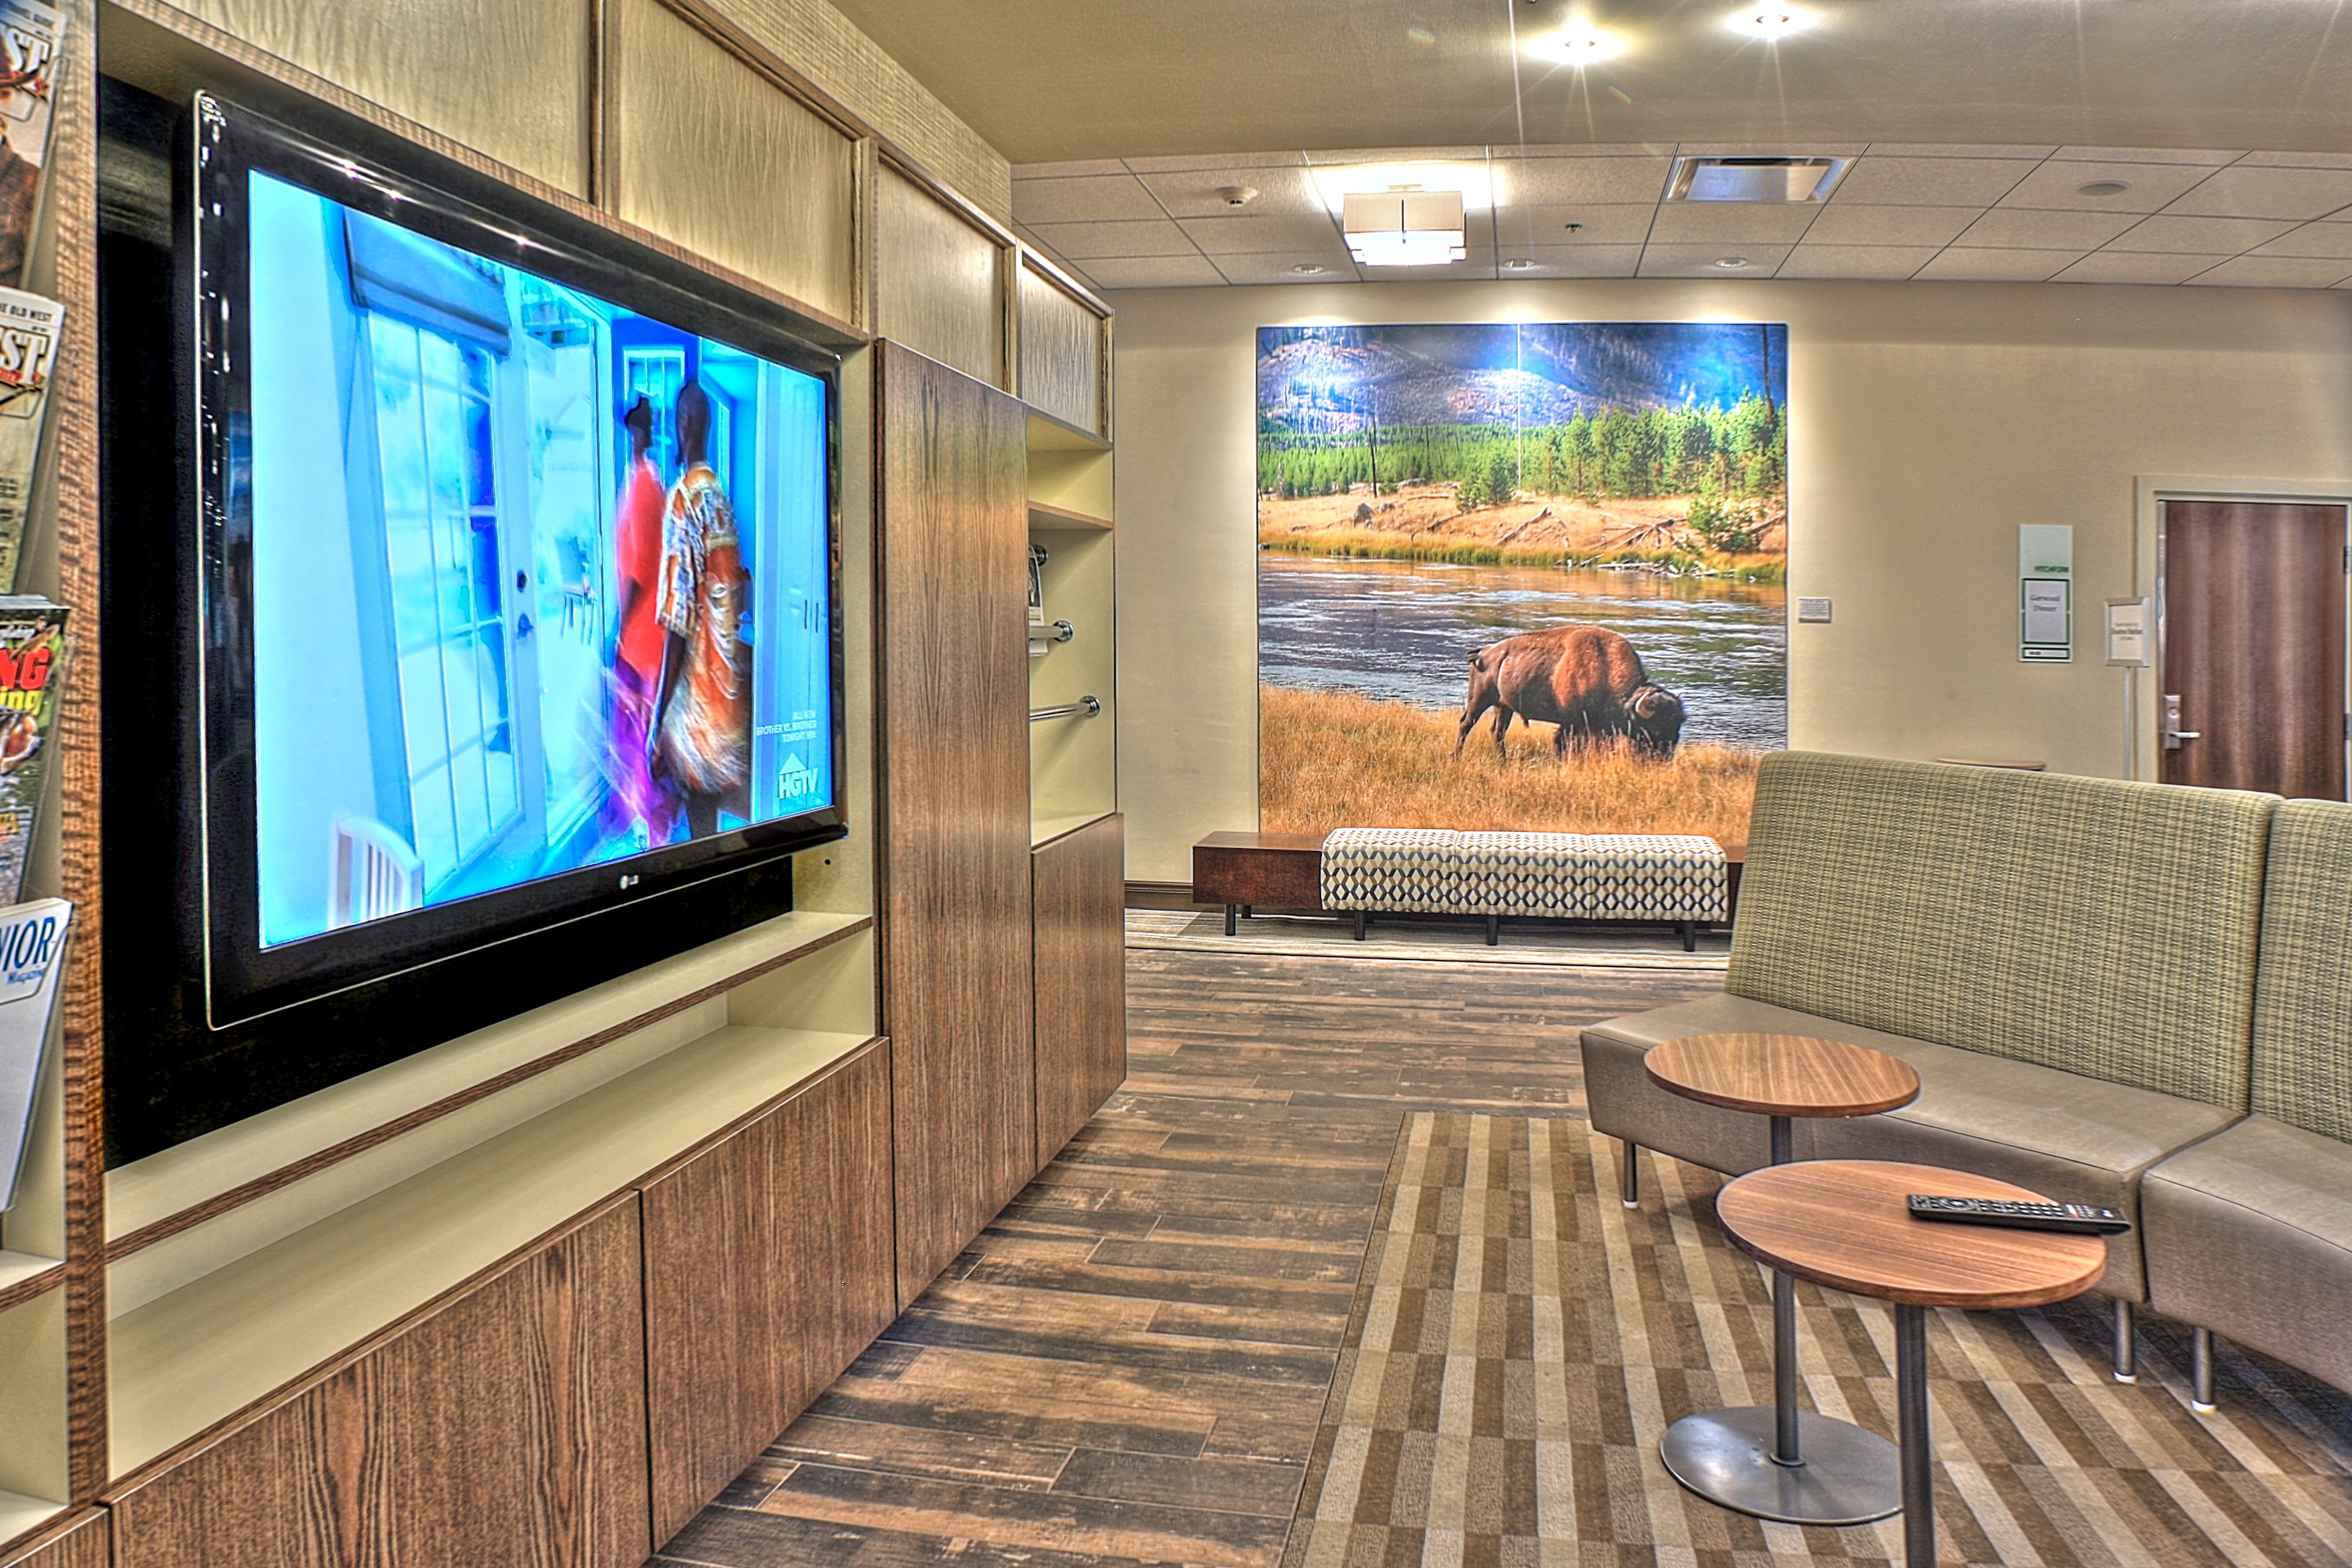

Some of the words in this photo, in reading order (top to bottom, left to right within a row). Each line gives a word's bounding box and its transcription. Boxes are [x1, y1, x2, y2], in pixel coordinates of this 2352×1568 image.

[0, 22, 50, 73] ST
[10, 305, 27, 318] OLD
[30, 309, 52, 322] WEST
[756, 724, 783, 736] BROTHER
[783, 722, 792, 732] VS.
[792, 719, 817, 731] BROTHER
[782, 731, 805, 743] TONIGHT
[779, 768, 817, 799] HGTV
